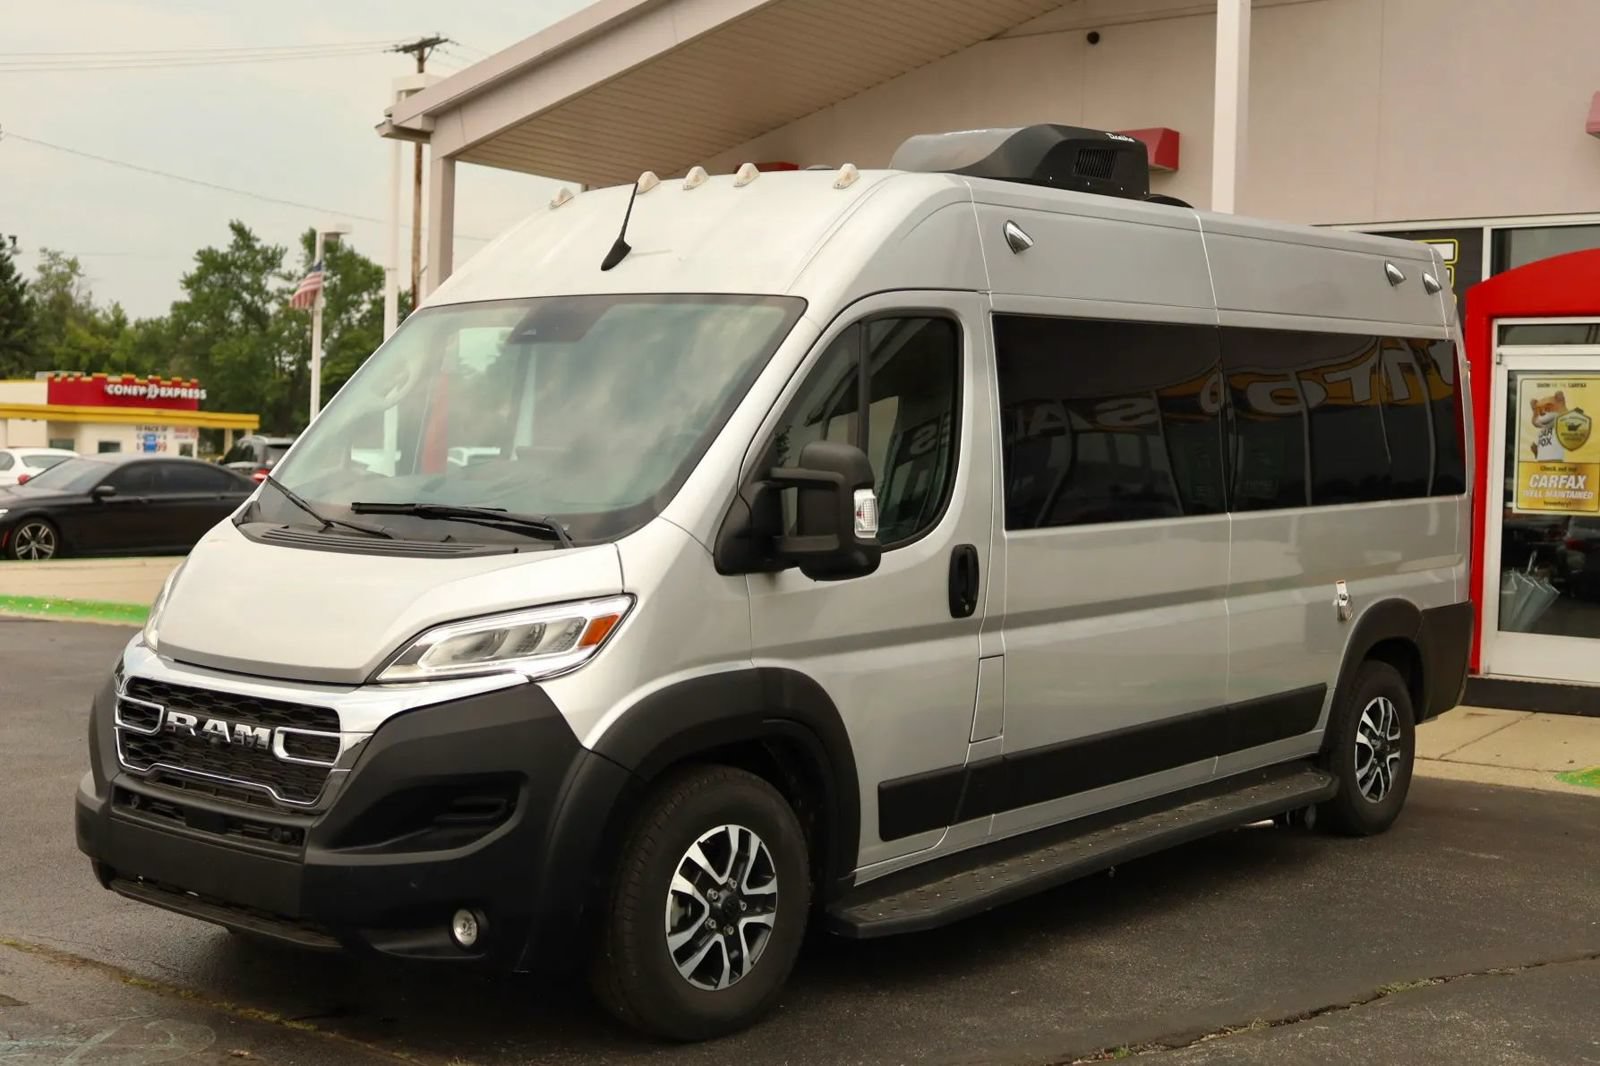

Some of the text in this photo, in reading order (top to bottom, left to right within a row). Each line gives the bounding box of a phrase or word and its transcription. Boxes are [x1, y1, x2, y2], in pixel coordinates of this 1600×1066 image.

[105, 384, 207, 399] CONEY EXPRESS
[1529, 473, 1587, 489] CARFAX
[164, 711, 271, 750] RAM
